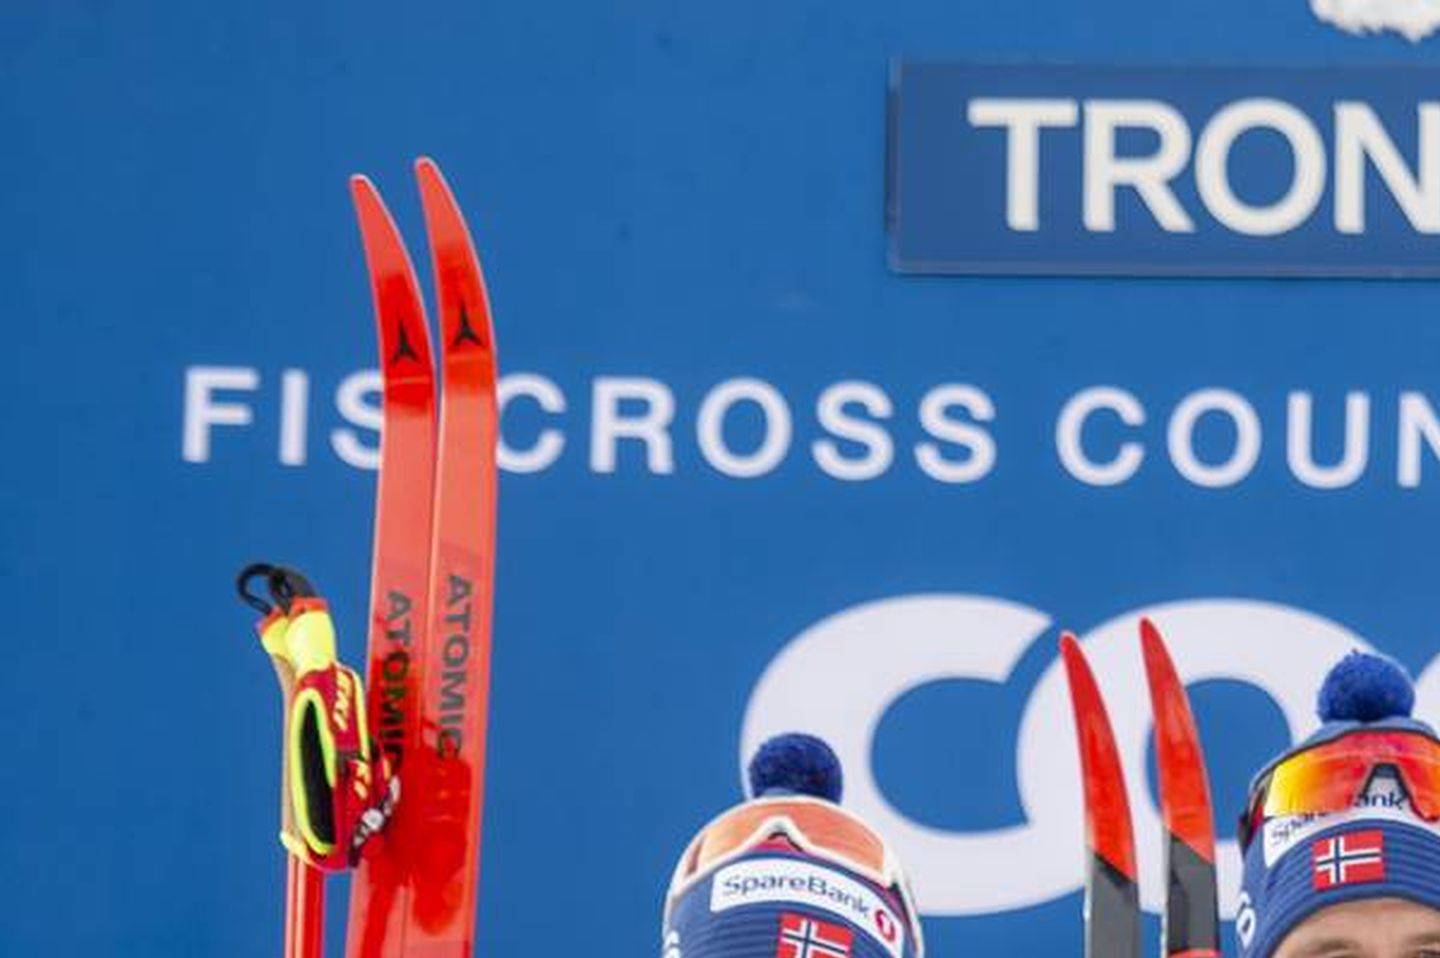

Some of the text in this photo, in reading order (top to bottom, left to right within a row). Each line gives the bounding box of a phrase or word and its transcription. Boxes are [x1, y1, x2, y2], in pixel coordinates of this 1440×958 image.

[183, 366, 386, 468] FIS
[496, 373, 998, 485] CROSS
[436, 573, 472, 760] ATOMIC
[722, 873, 873, 921] SpareBank
